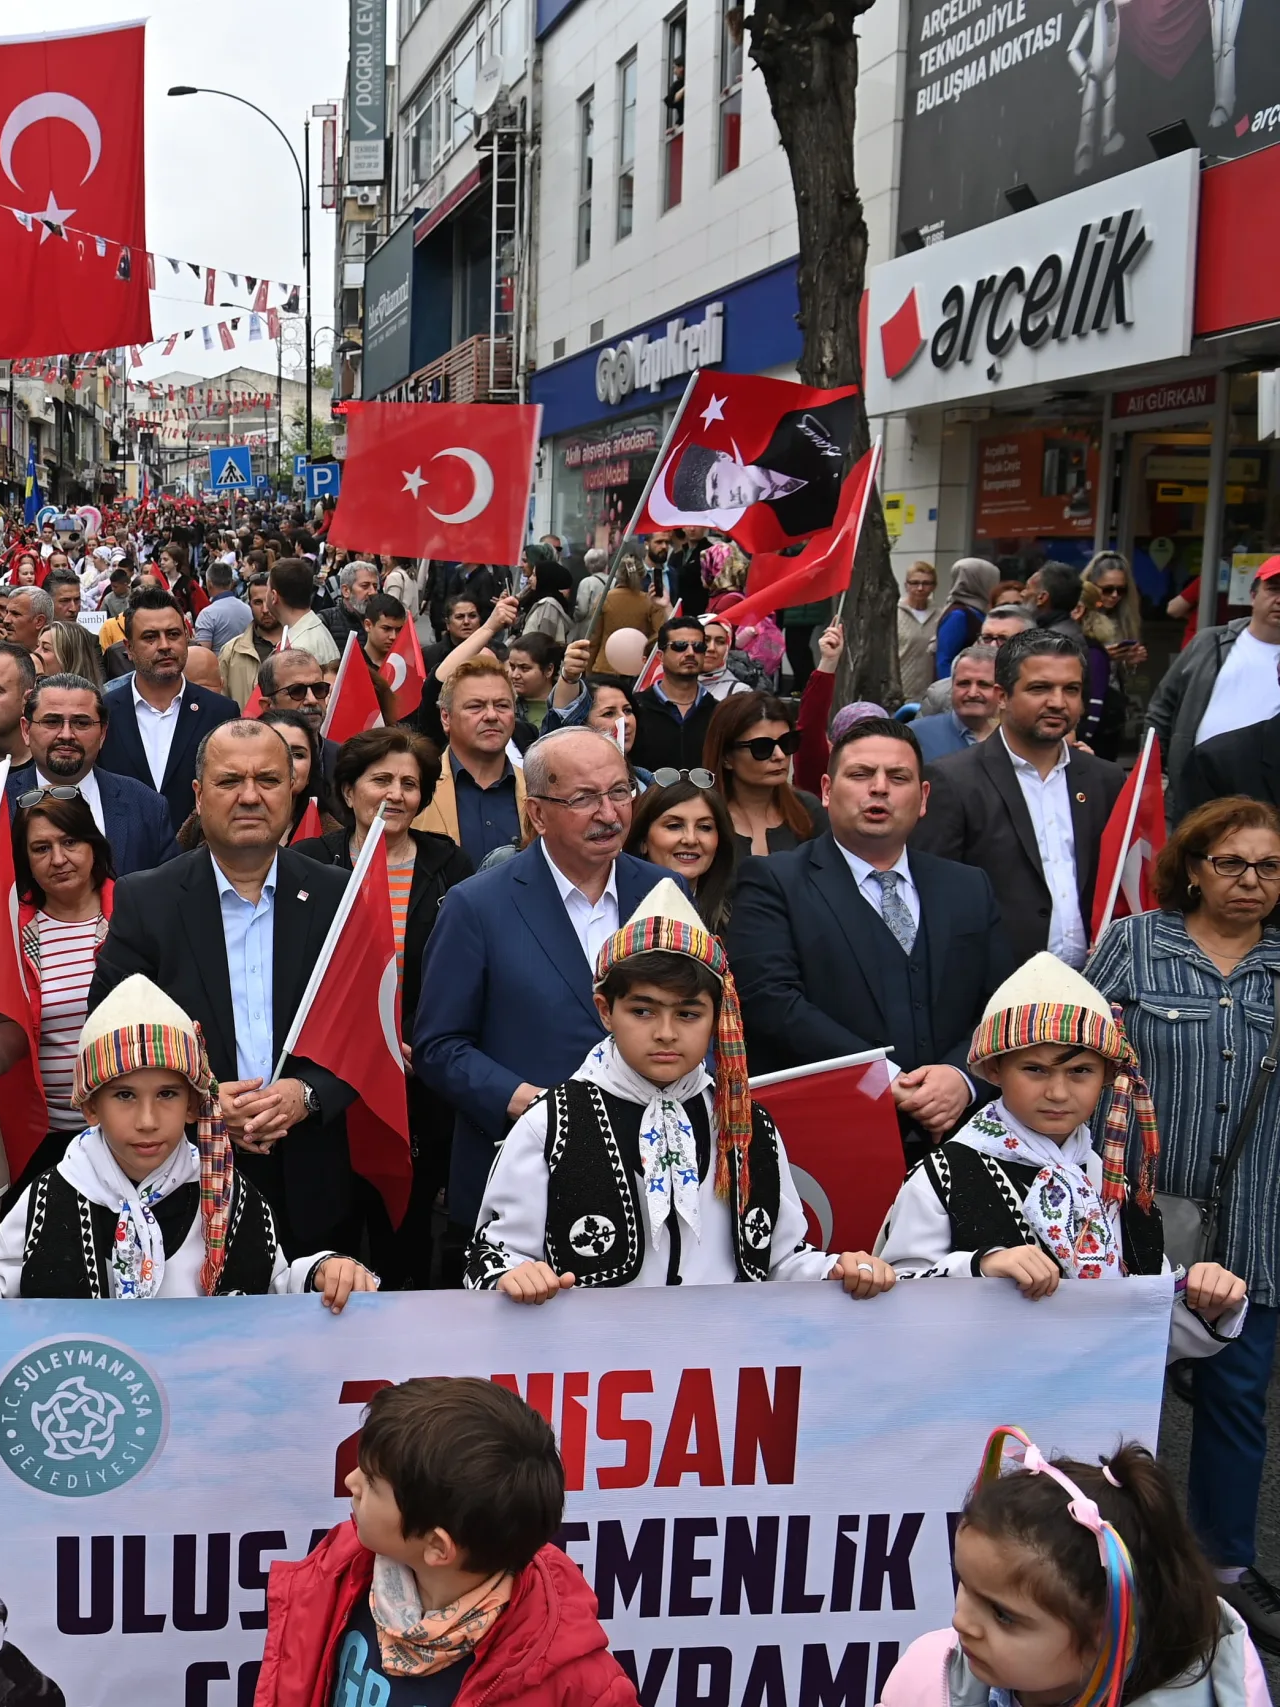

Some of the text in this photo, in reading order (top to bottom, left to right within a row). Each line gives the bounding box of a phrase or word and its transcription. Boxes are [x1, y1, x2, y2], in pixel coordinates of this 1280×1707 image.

[356, 0, 373, 36] CEV
[919, 1, 1026, 78] TEKNOLOJİYLE
[916, 13, 1063, 116] BULUŞMA NOKTASI
[931, 208, 1152, 382] arçelik
[1146, 384, 1208, 411] GÜRKAN
[313, 467, 332, 496] P
[77, 615, 105, 624] sambl
[14, 1349, 152, 1418] SÜLEYMANPAŞA
[9, 1441, 144, 1489] BELEDİYESİ
[56, 1528, 334, 1635] ULUS
